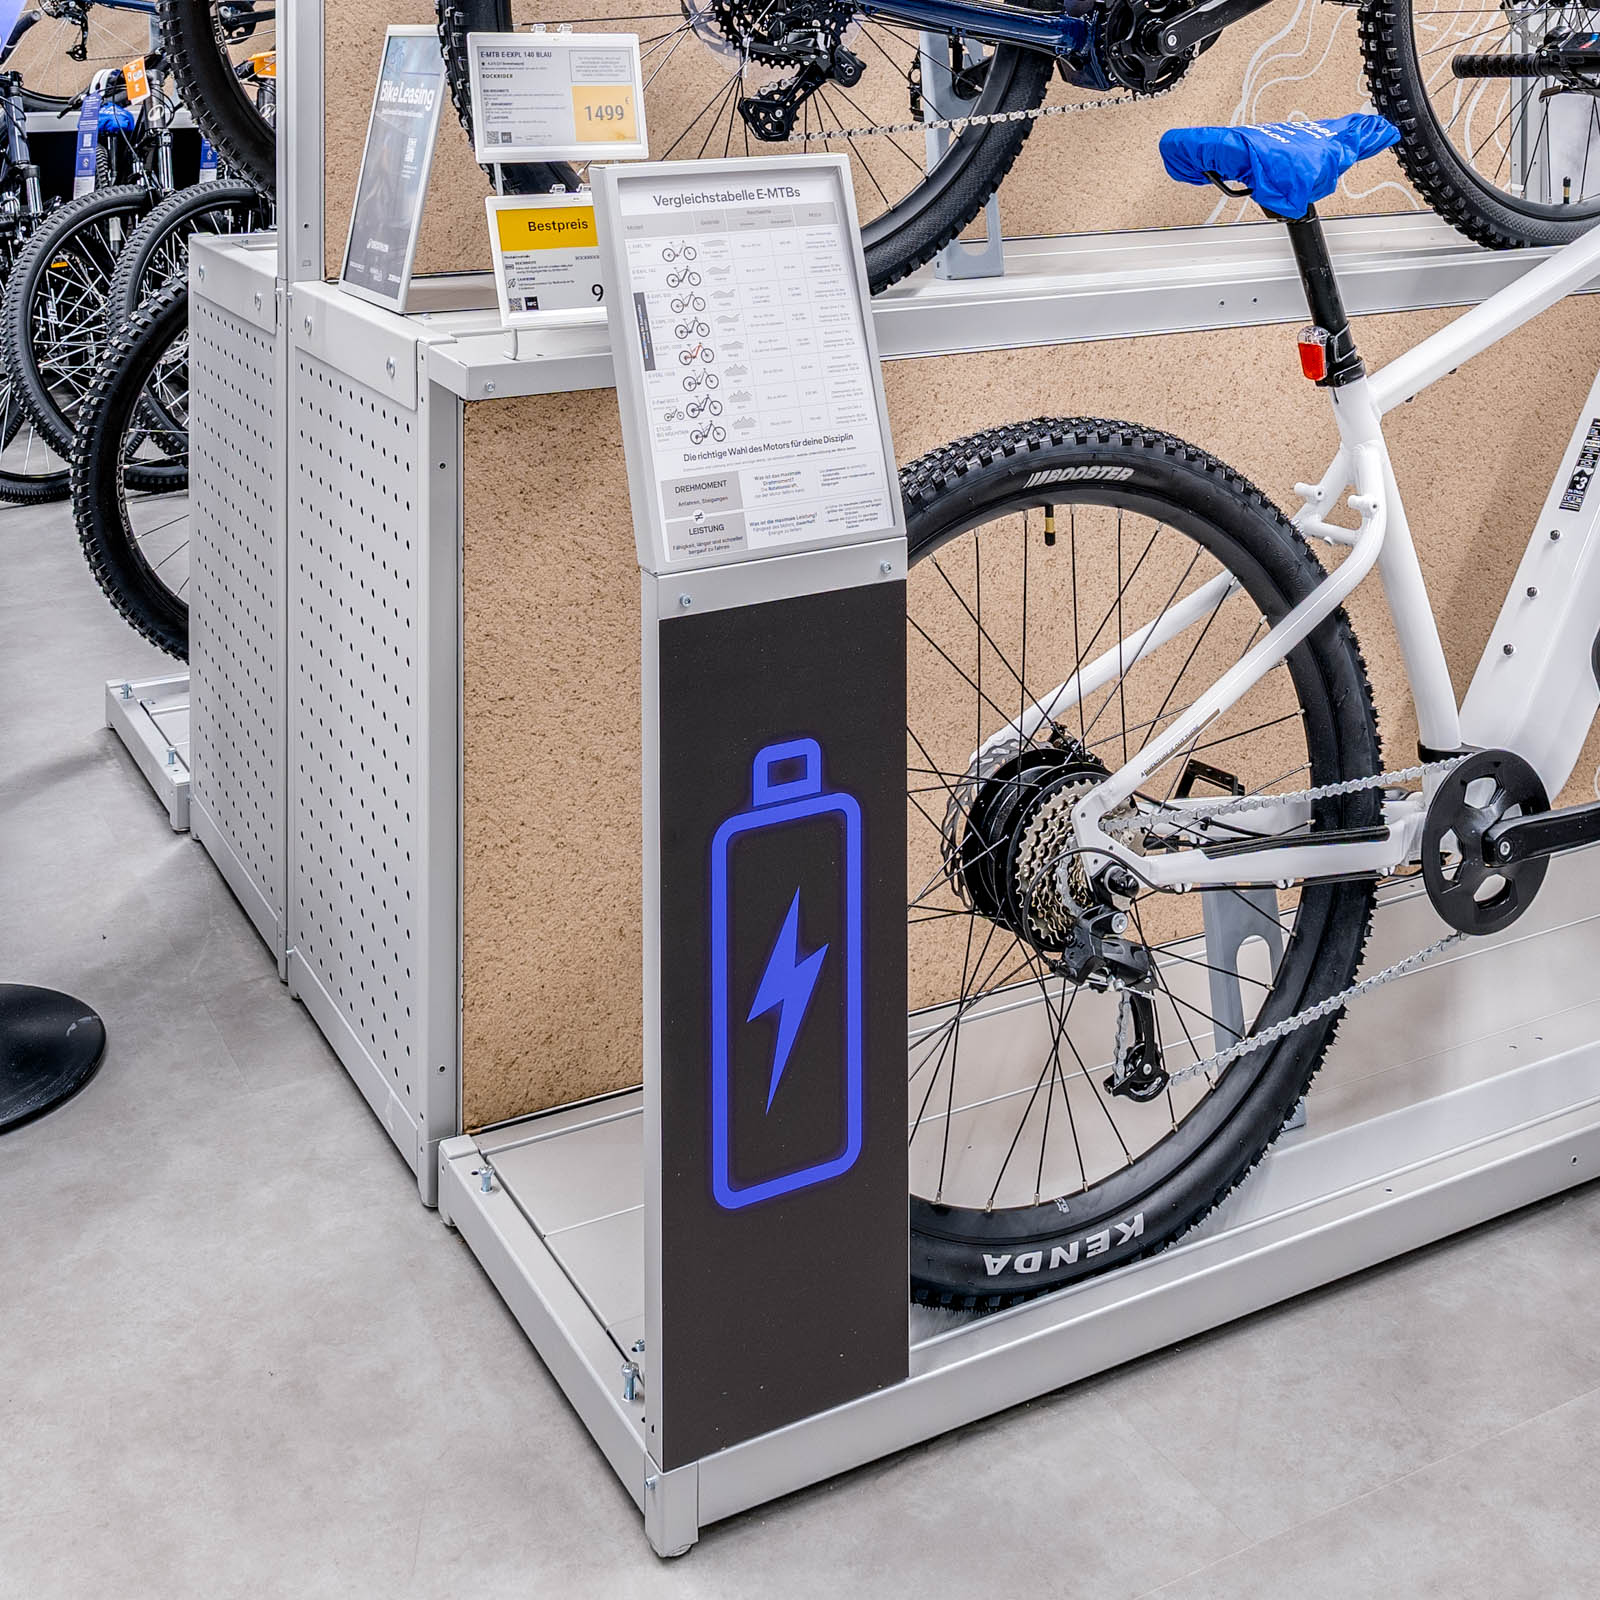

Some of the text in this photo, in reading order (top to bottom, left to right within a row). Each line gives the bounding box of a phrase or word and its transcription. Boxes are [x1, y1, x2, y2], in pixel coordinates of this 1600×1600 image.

[380, 79, 436, 111] Bike Leasing
[584, 105, 624, 121] 1499
[653, 186, 800, 208] Vergleichstabelle E-MTBs
[528, 218, 588, 232] Bestpreis
[591, 284, 604, 301] 9
[683, 453, 697, 462] Die
[697, 450, 728, 462] richtige
[727, 447, 748, 456] Wahl
[749, 445, 763, 454] des
[763, 442, 791, 451] Motors
[791, 439, 802, 448] für
[802, 437, 823, 446] deine
[823, 433, 854, 444] Disziplin
[1043, 466, 1135, 484] BOOSTER
[675, 480, 727, 493] DREHMOMENT
[689, 523, 724, 535] LEISTUNG
[982, 1212, 1145, 1276] KENDA
